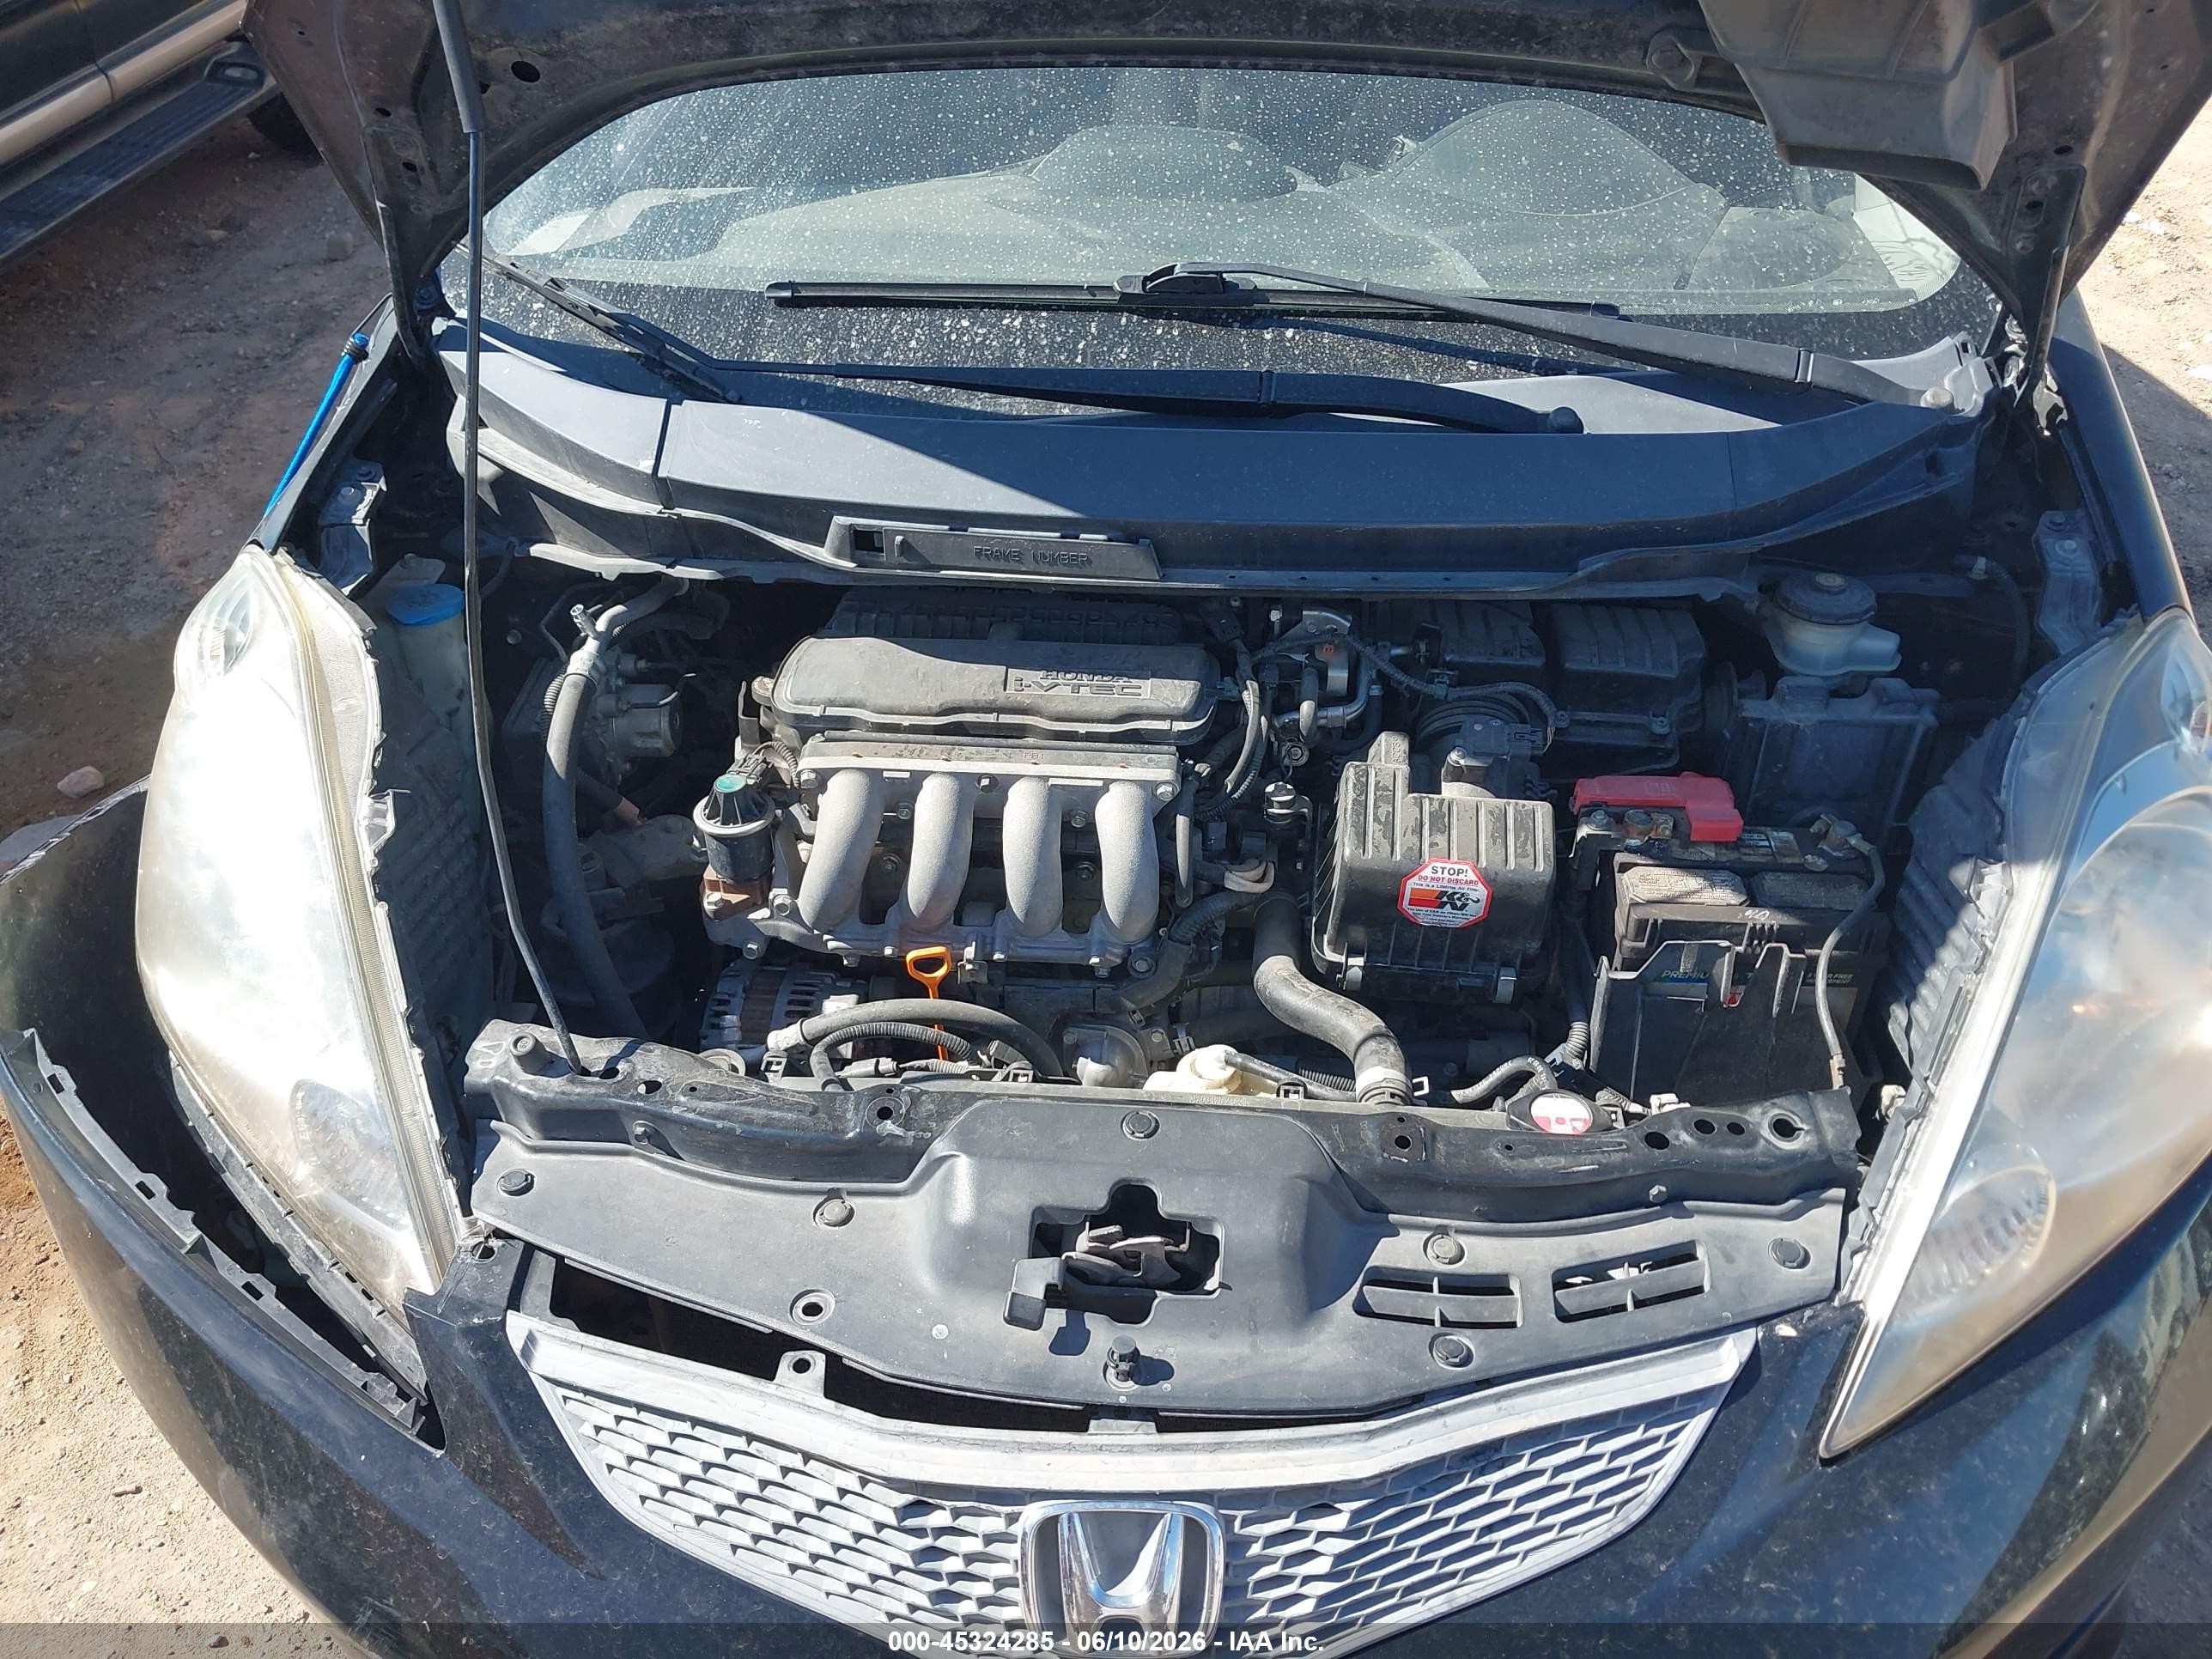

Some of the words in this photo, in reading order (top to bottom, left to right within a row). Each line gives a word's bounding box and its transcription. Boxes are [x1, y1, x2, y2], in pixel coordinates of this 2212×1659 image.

[973, 545, 1022, 560] FRAME
[1030, 550, 1089, 565] NUMBER
[1039, 670, 1133, 684] HONDA
[1431, 866, 1468, 877] STOP!
[1447, 878, 1479, 886] DISCARD
[1661, 969, 1710, 979] PREMIU
